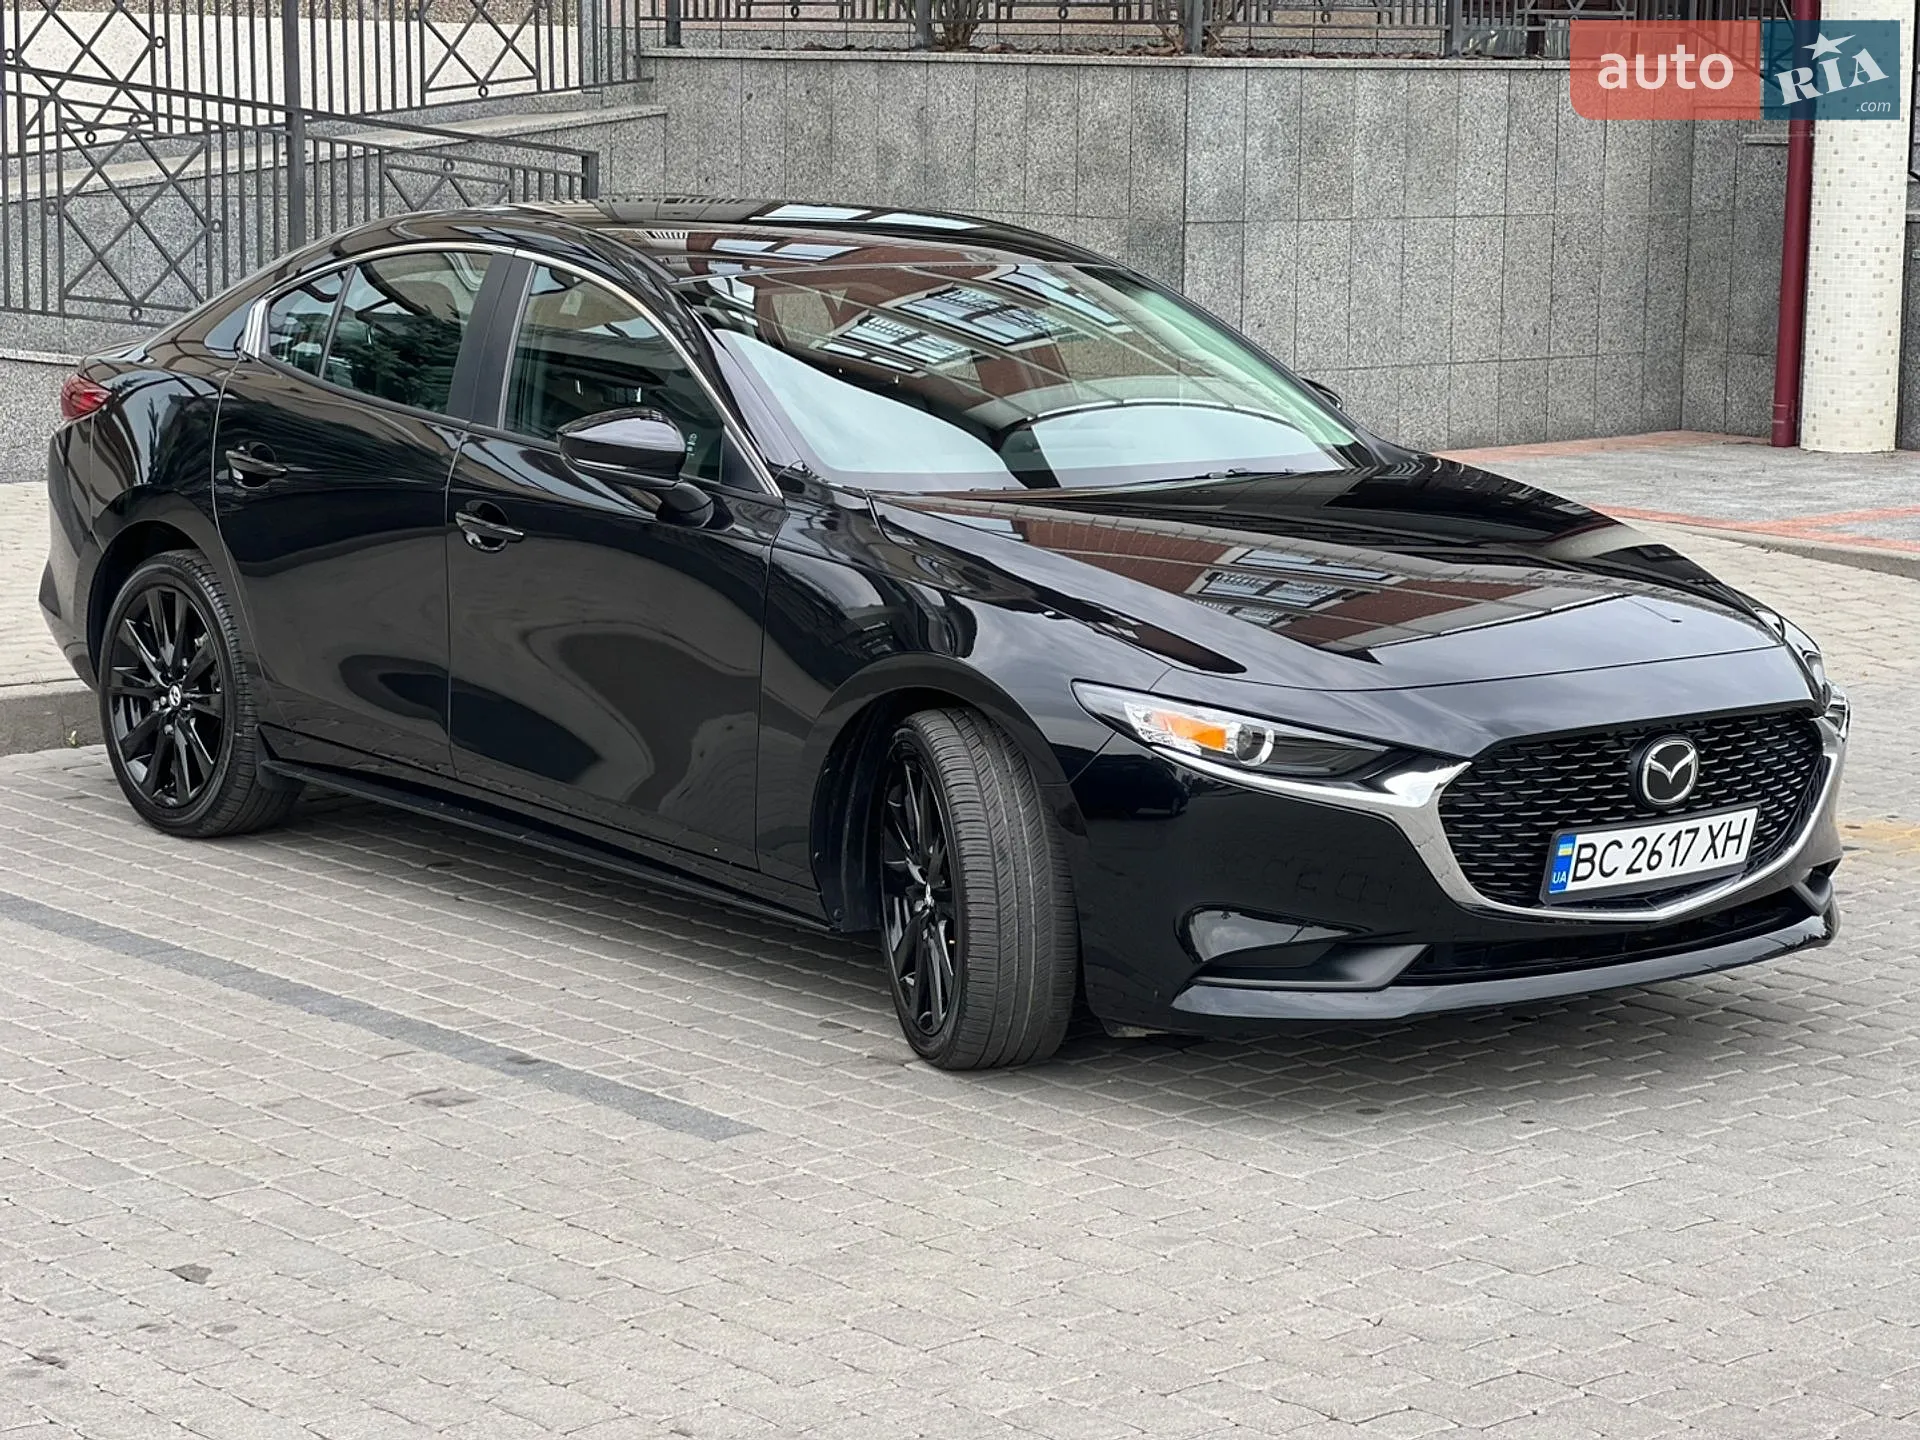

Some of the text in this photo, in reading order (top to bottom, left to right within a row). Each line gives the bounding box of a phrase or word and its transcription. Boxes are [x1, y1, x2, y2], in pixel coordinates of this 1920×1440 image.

[1571, 818, 1748, 883] BC 2617 XH
[1552, 871, 1567, 884] UA
